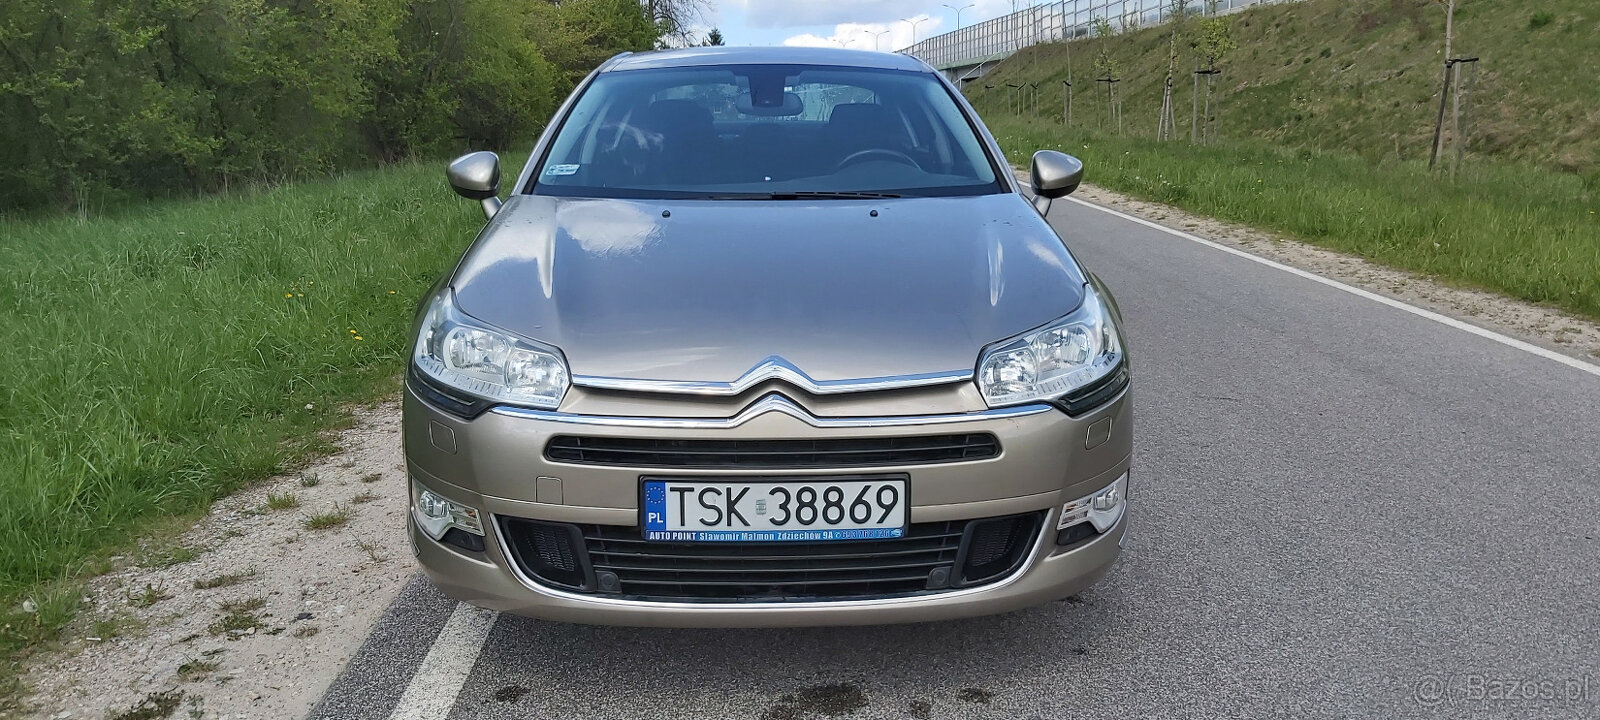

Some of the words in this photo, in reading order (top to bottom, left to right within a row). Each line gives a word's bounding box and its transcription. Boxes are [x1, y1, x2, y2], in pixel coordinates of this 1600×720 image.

[670, 487, 751, 527] TSK
[768, 485, 899, 527] 38869
[648, 512, 664, 523] PL
[649, 531, 670, 541] AUTO
[672, 531, 697, 541] POINT
[823, 531, 834, 540] 9A
